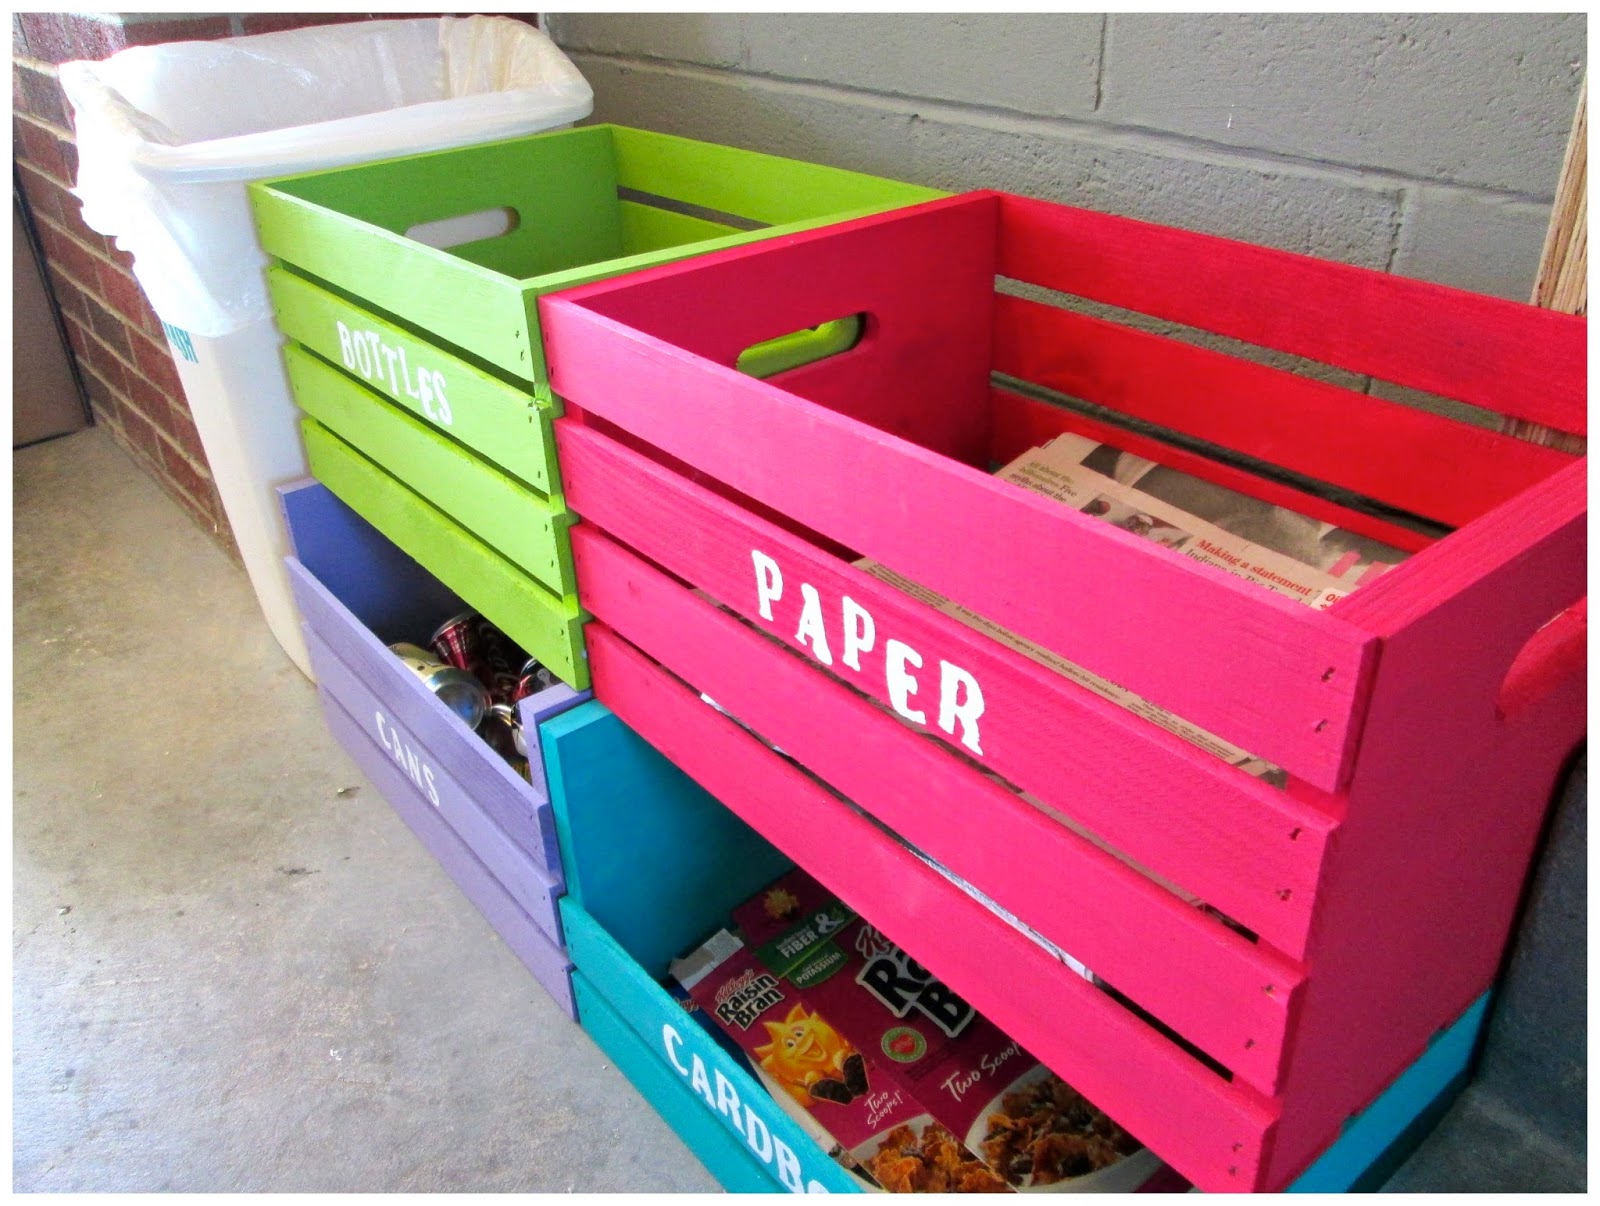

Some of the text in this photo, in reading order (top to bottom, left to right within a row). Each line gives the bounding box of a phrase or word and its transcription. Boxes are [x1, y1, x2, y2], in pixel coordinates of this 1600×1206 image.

[337, 320, 452, 425] BOTTLES
[1197, 539, 1242, 566] Making
[1239, 560, 1249, 569] a
[1252, 565, 1313, 597] statement
[751, 549, 986, 757] PAPER
[375, 711, 440, 807] CANS
[780, 930, 819, 959] FIBER
[796, 952, 842, 985] POTASSIUM
[714, 973, 780, 1026] Raisin
[732, 987, 786, 1032] Bran
[663, 1023, 830, 1193] CARDB
[864, 1091, 889, 1114] Two
[867, 1091, 904, 1130] Scoops!
[940, 1070, 981, 1103] Two
